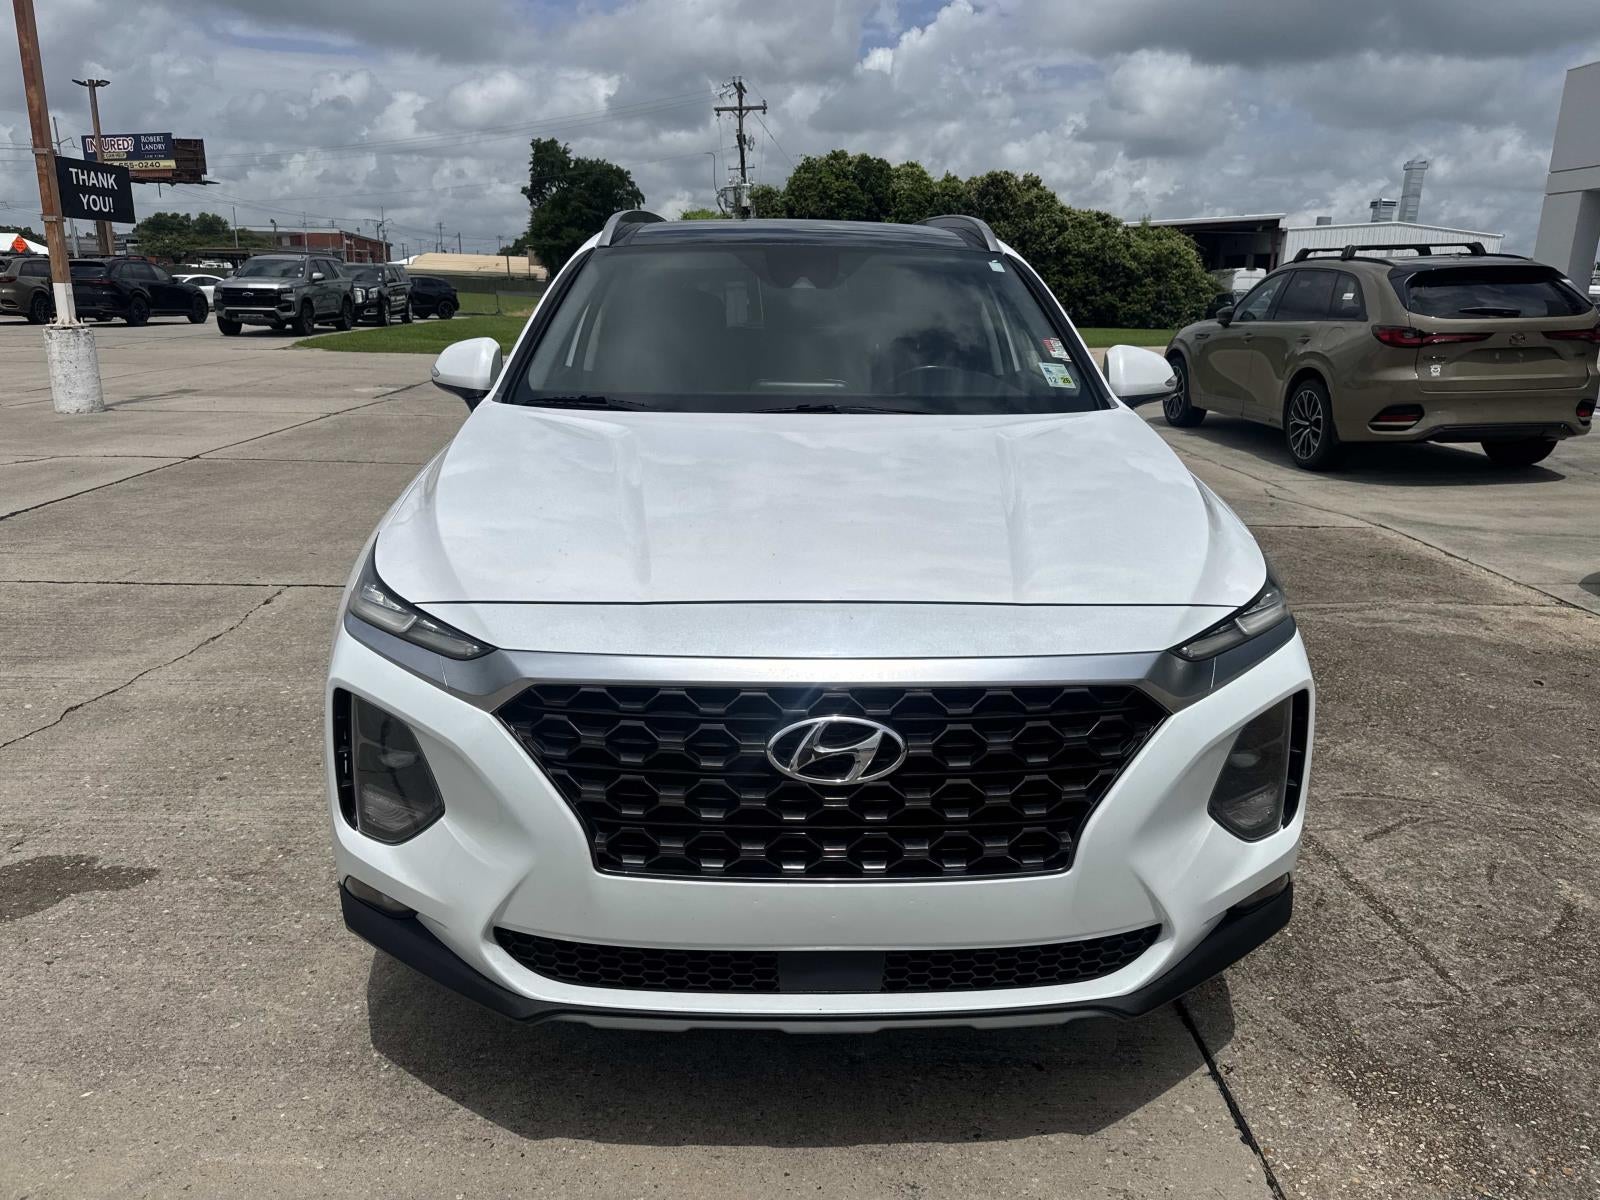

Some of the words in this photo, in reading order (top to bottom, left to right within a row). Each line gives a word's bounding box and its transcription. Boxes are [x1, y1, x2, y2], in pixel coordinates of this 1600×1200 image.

[86, 137, 134, 153] INURED?
[141, 143, 166, 151] LANDRY
[69, 167, 118, 190] THANK
[79, 193, 114, 213] YOU!
